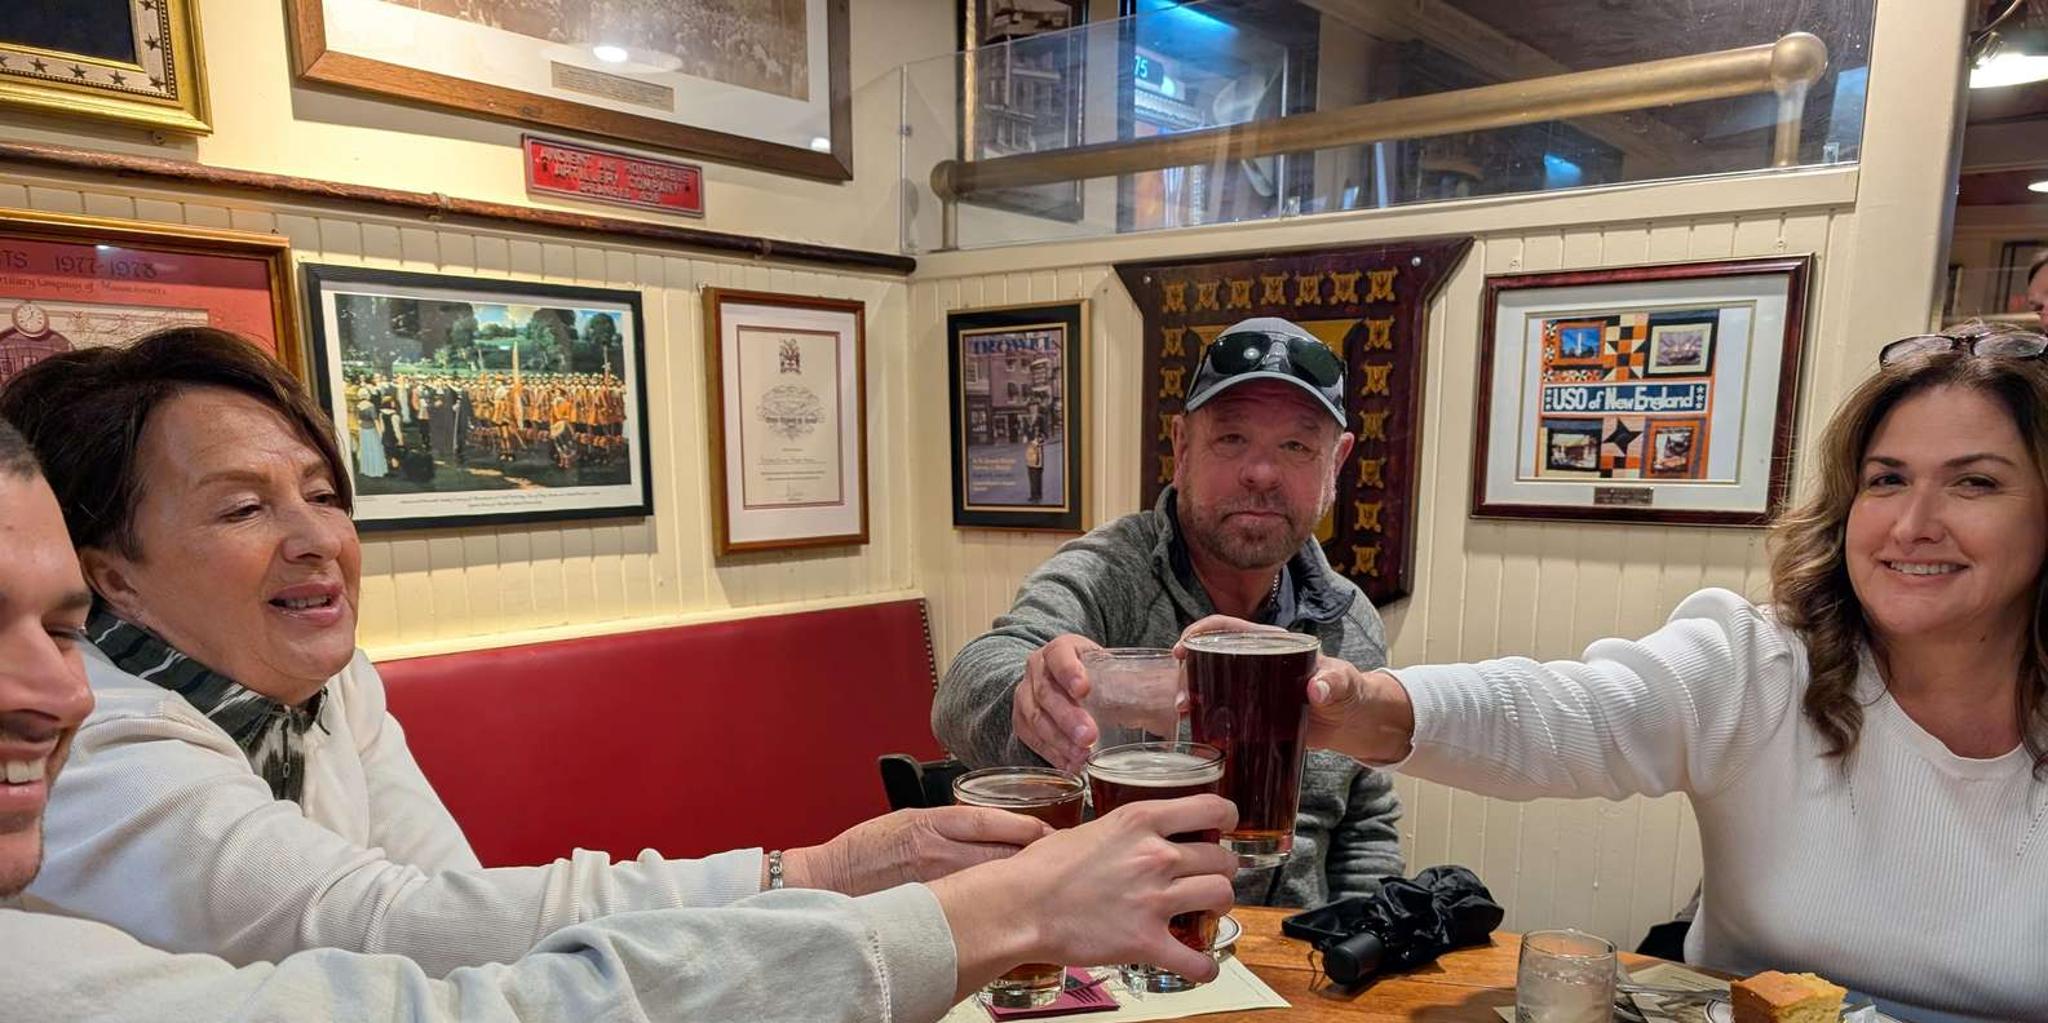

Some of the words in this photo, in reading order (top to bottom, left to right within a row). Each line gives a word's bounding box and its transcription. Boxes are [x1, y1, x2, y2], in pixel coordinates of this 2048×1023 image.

[540, 147, 592, 169] ANCIENT
[624, 161, 690, 182] HONORABLE
[554, 163, 618, 185] ARTILLERY
[628, 175, 680, 194] COMPANY
[1552, 387, 1589, 410] USO
[1588, 390, 1604, 409] of
[1605, 386, 1634, 410] New
[1634, 385, 1694, 411] England
